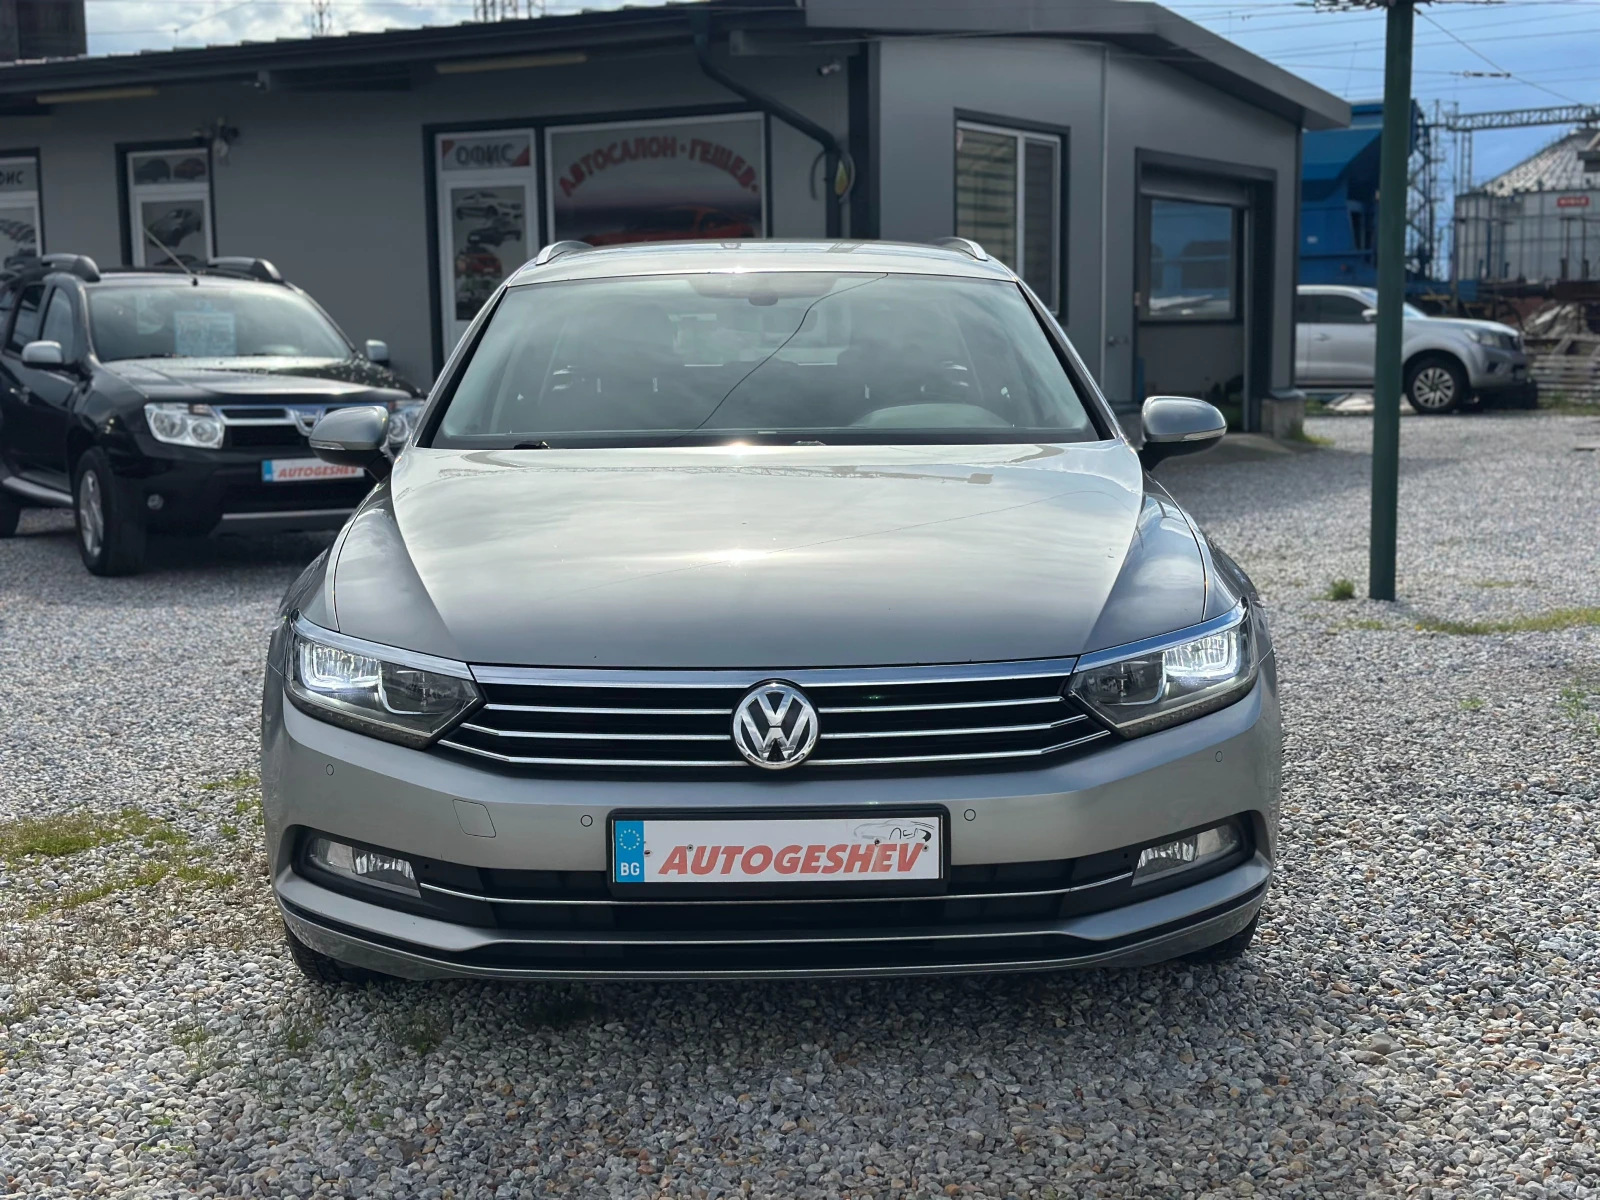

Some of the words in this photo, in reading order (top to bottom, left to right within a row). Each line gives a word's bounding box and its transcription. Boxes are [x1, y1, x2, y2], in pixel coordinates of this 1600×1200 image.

[456, 143, 514, 164] ОФИС
[278, 465, 358, 478] AUTOGESHEV
[735, 687, 816, 765] VW
[620, 862, 640, 877] BG
[658, 842, 925, 876] AUTOGESHEV
